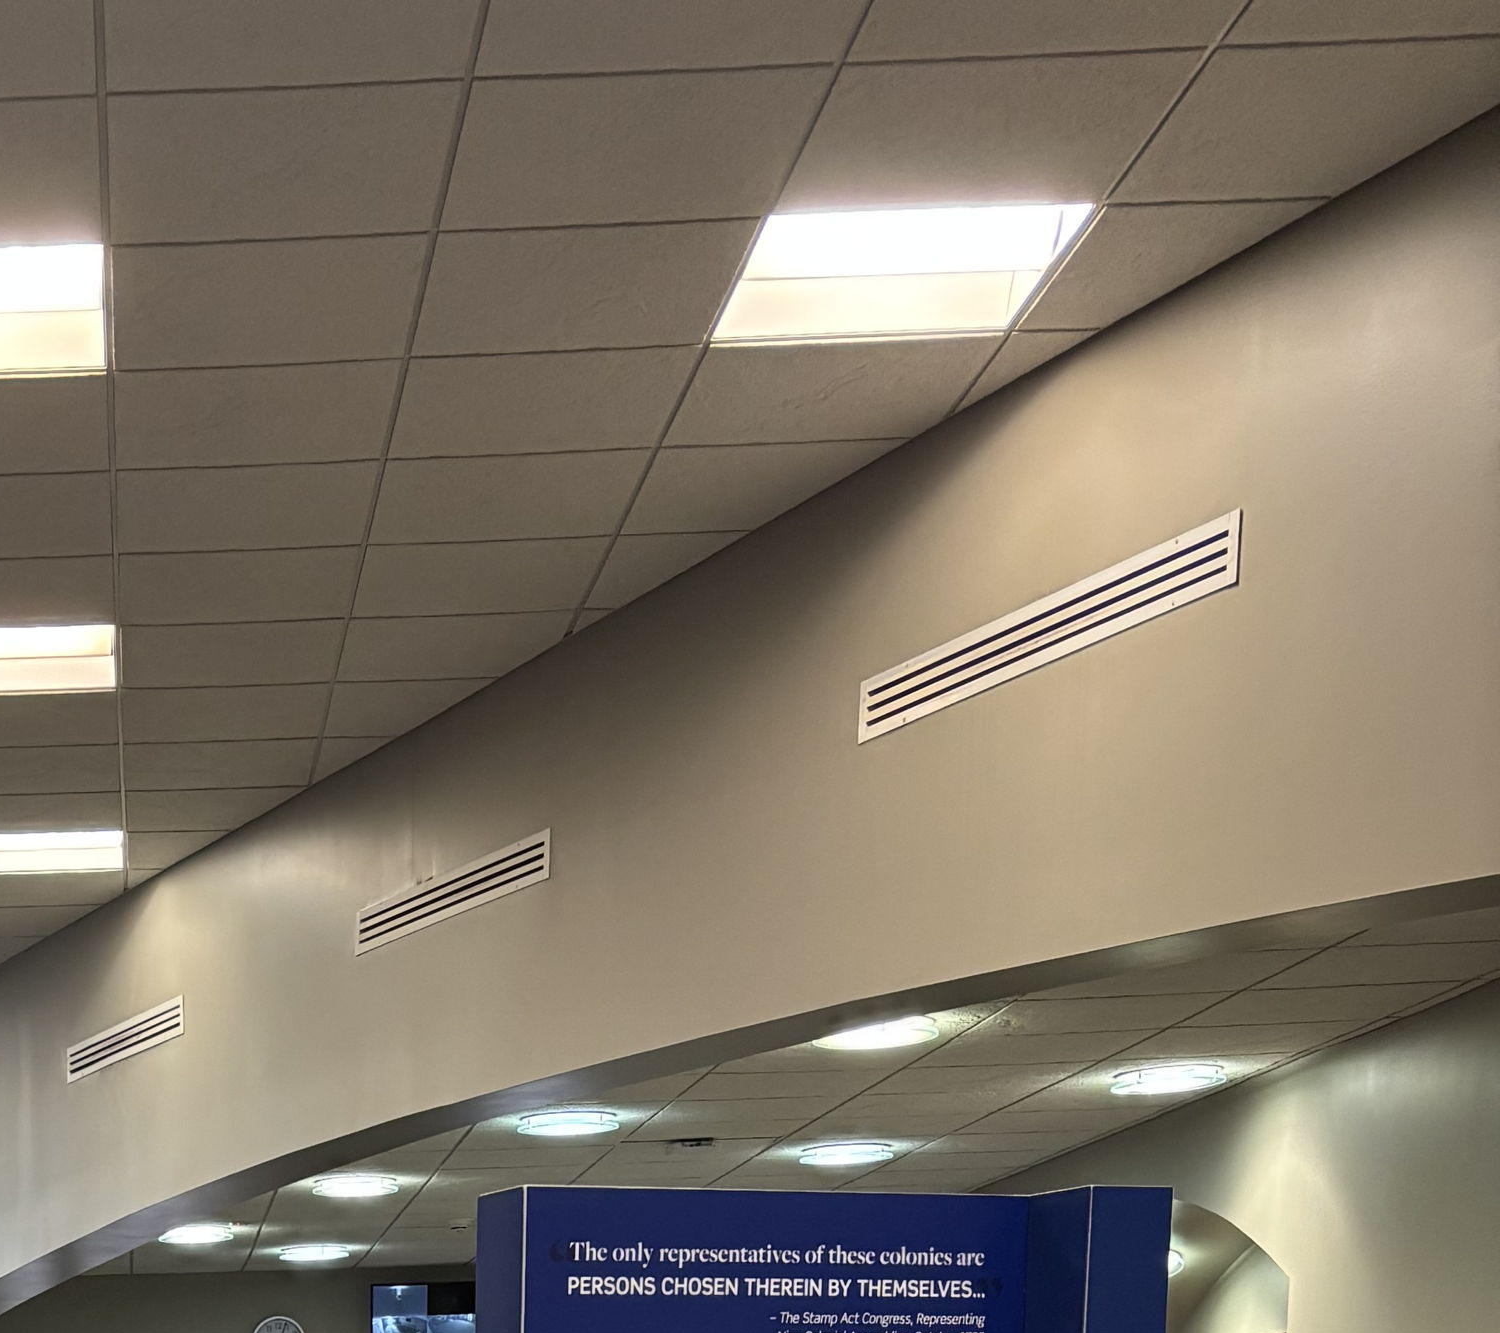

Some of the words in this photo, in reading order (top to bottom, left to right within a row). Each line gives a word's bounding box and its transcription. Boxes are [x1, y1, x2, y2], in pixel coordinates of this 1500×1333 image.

[570, 1241, 607, 1261] The
[613, 1242, 653, 1268] only
[660, 1245, 800, 1268] representatives
[805, 1245, 825, 1263] of
[829, 1245, 875, 1264] these
[880, 1247, 952, 1265] colonies
[957, 1253, 984, 1266] are
[568, 1277, 655, 1295] PERSONS
[662, 1277, 738, 1295] CHOSEN
[745, 1278, 822, 1296] THEREIN
[829, 1279, 850, 1296] BY
[857, 1279, 985, 1298] THEMSELVES...
[781, 1312, 800, 1323] The
[803, 1312, 837, 1326] Stamp
[840, 1313, 859, 1324] Act
[862, 1312, 913, 1327] Congress,
[917, 1313, 985, 1328] Representing
